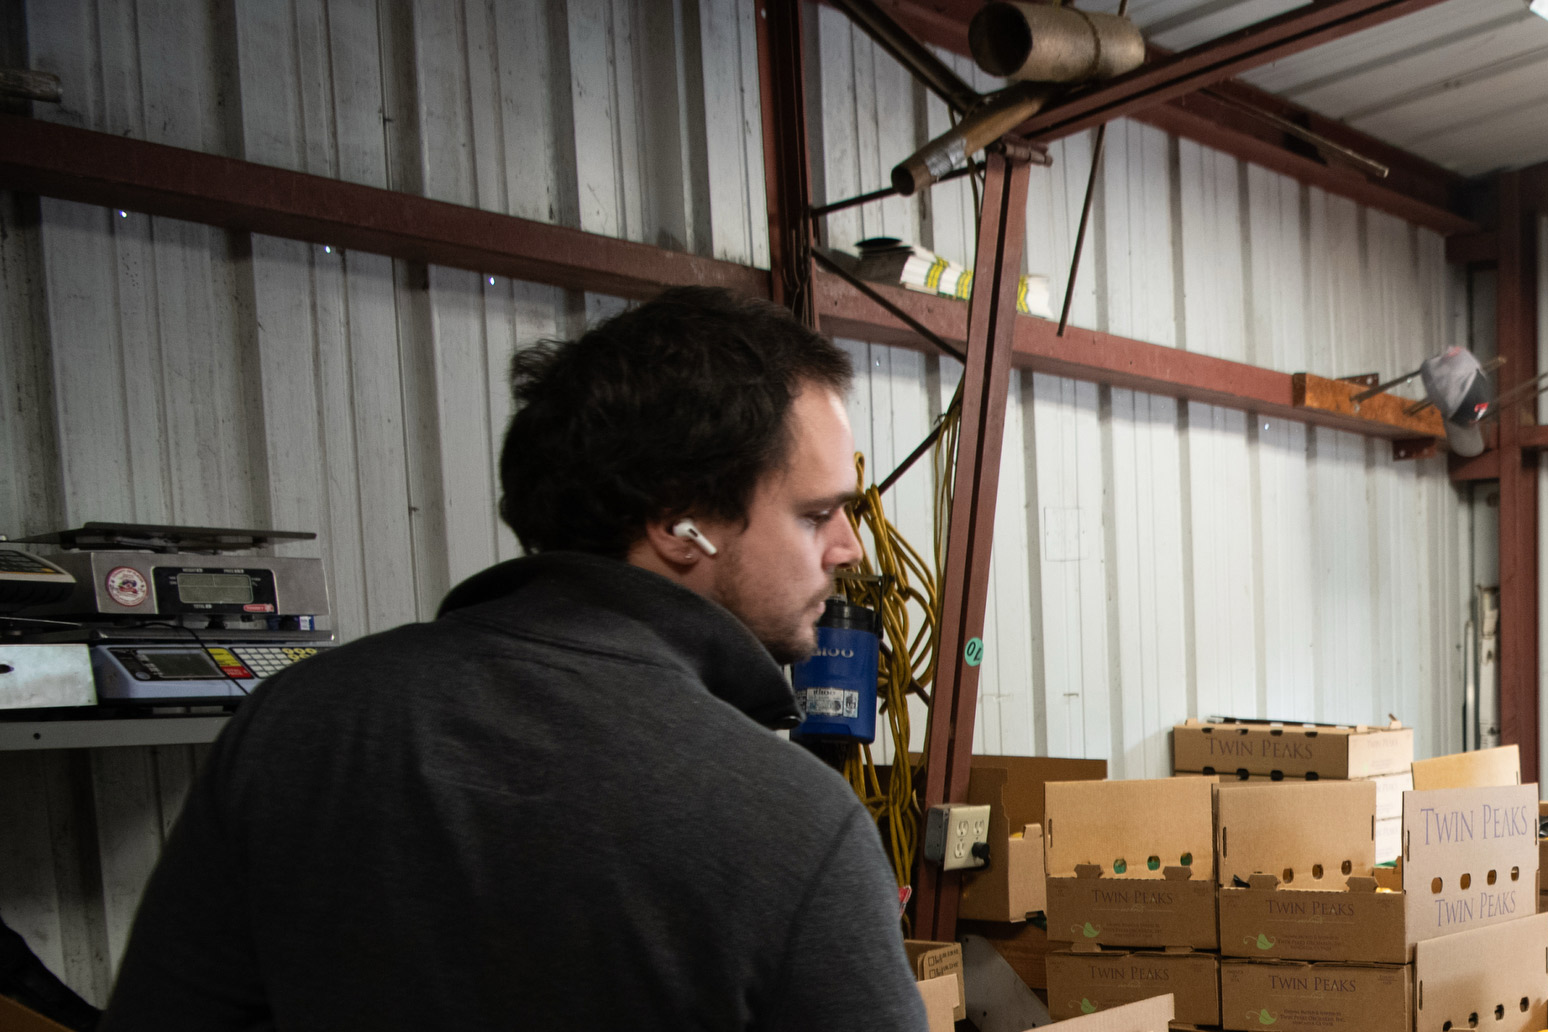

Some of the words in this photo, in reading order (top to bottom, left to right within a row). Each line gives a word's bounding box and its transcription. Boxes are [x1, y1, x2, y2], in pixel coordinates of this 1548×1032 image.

[1205, 737, 1253, 756] TWIN
[1262, 739, 1313, 760] PEAKS
[1420, 807, 1474, 845] TWIN
[1482, 802, 1528, 840] PEAKS
[1091, 889, 1128, 904] TWIN
[1133, 891, 1173, 905] PEAKS
[1265, 899, 1306, 914] TWIN
[1312, 901, 1355, 916] PEAKS
[1435, 898, 1473, 928] TWIN
[1479, 890, 1517, 919] PEAKS
[1088, 964, 1125, 980] TWIN
[1131, 966, 1170, 981] PEAKS
[1267, 974, 1308, 991] TWIN
[1314, 976, 1357, 993] PEAKS
